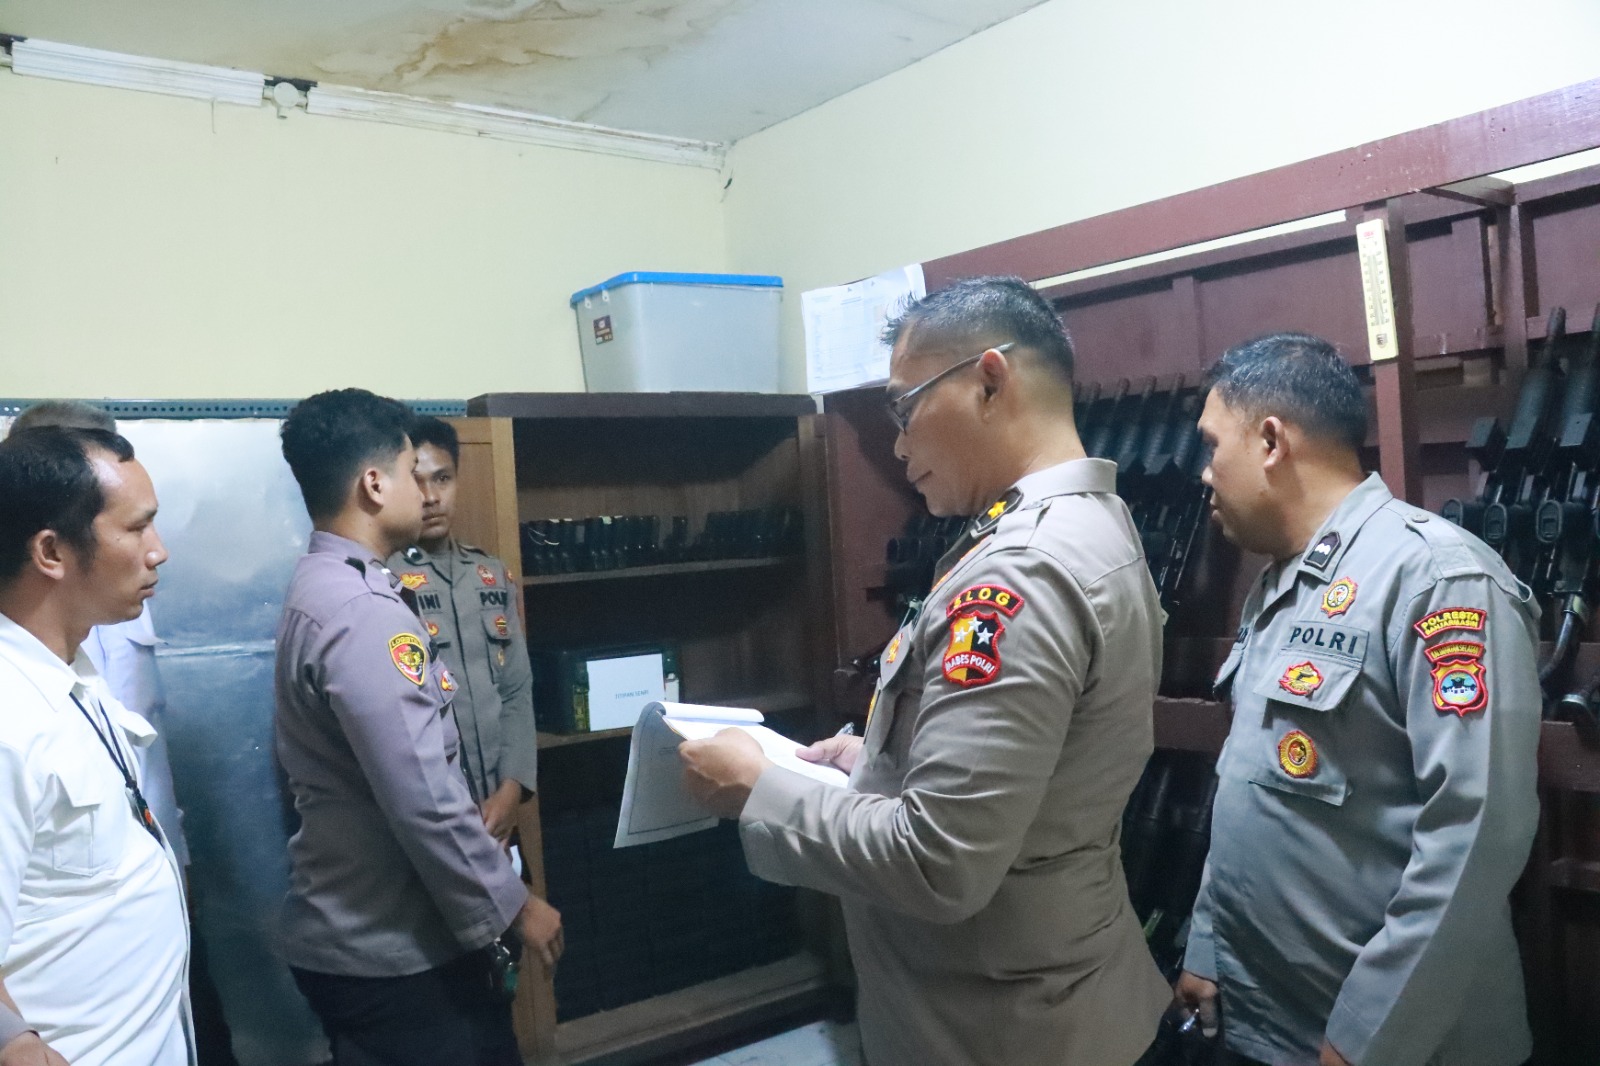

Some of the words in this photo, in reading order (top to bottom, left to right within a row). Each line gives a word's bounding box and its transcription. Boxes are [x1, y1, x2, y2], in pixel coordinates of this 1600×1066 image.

[953, 587, 1010, 609] SLOG
[1421, 611, 1479, 631] POLRESTA
[1289, 627, 1358, 654] POLRI
[945, 654, 969, 672] MABES
[970, 655, 995, 674] POLRI
